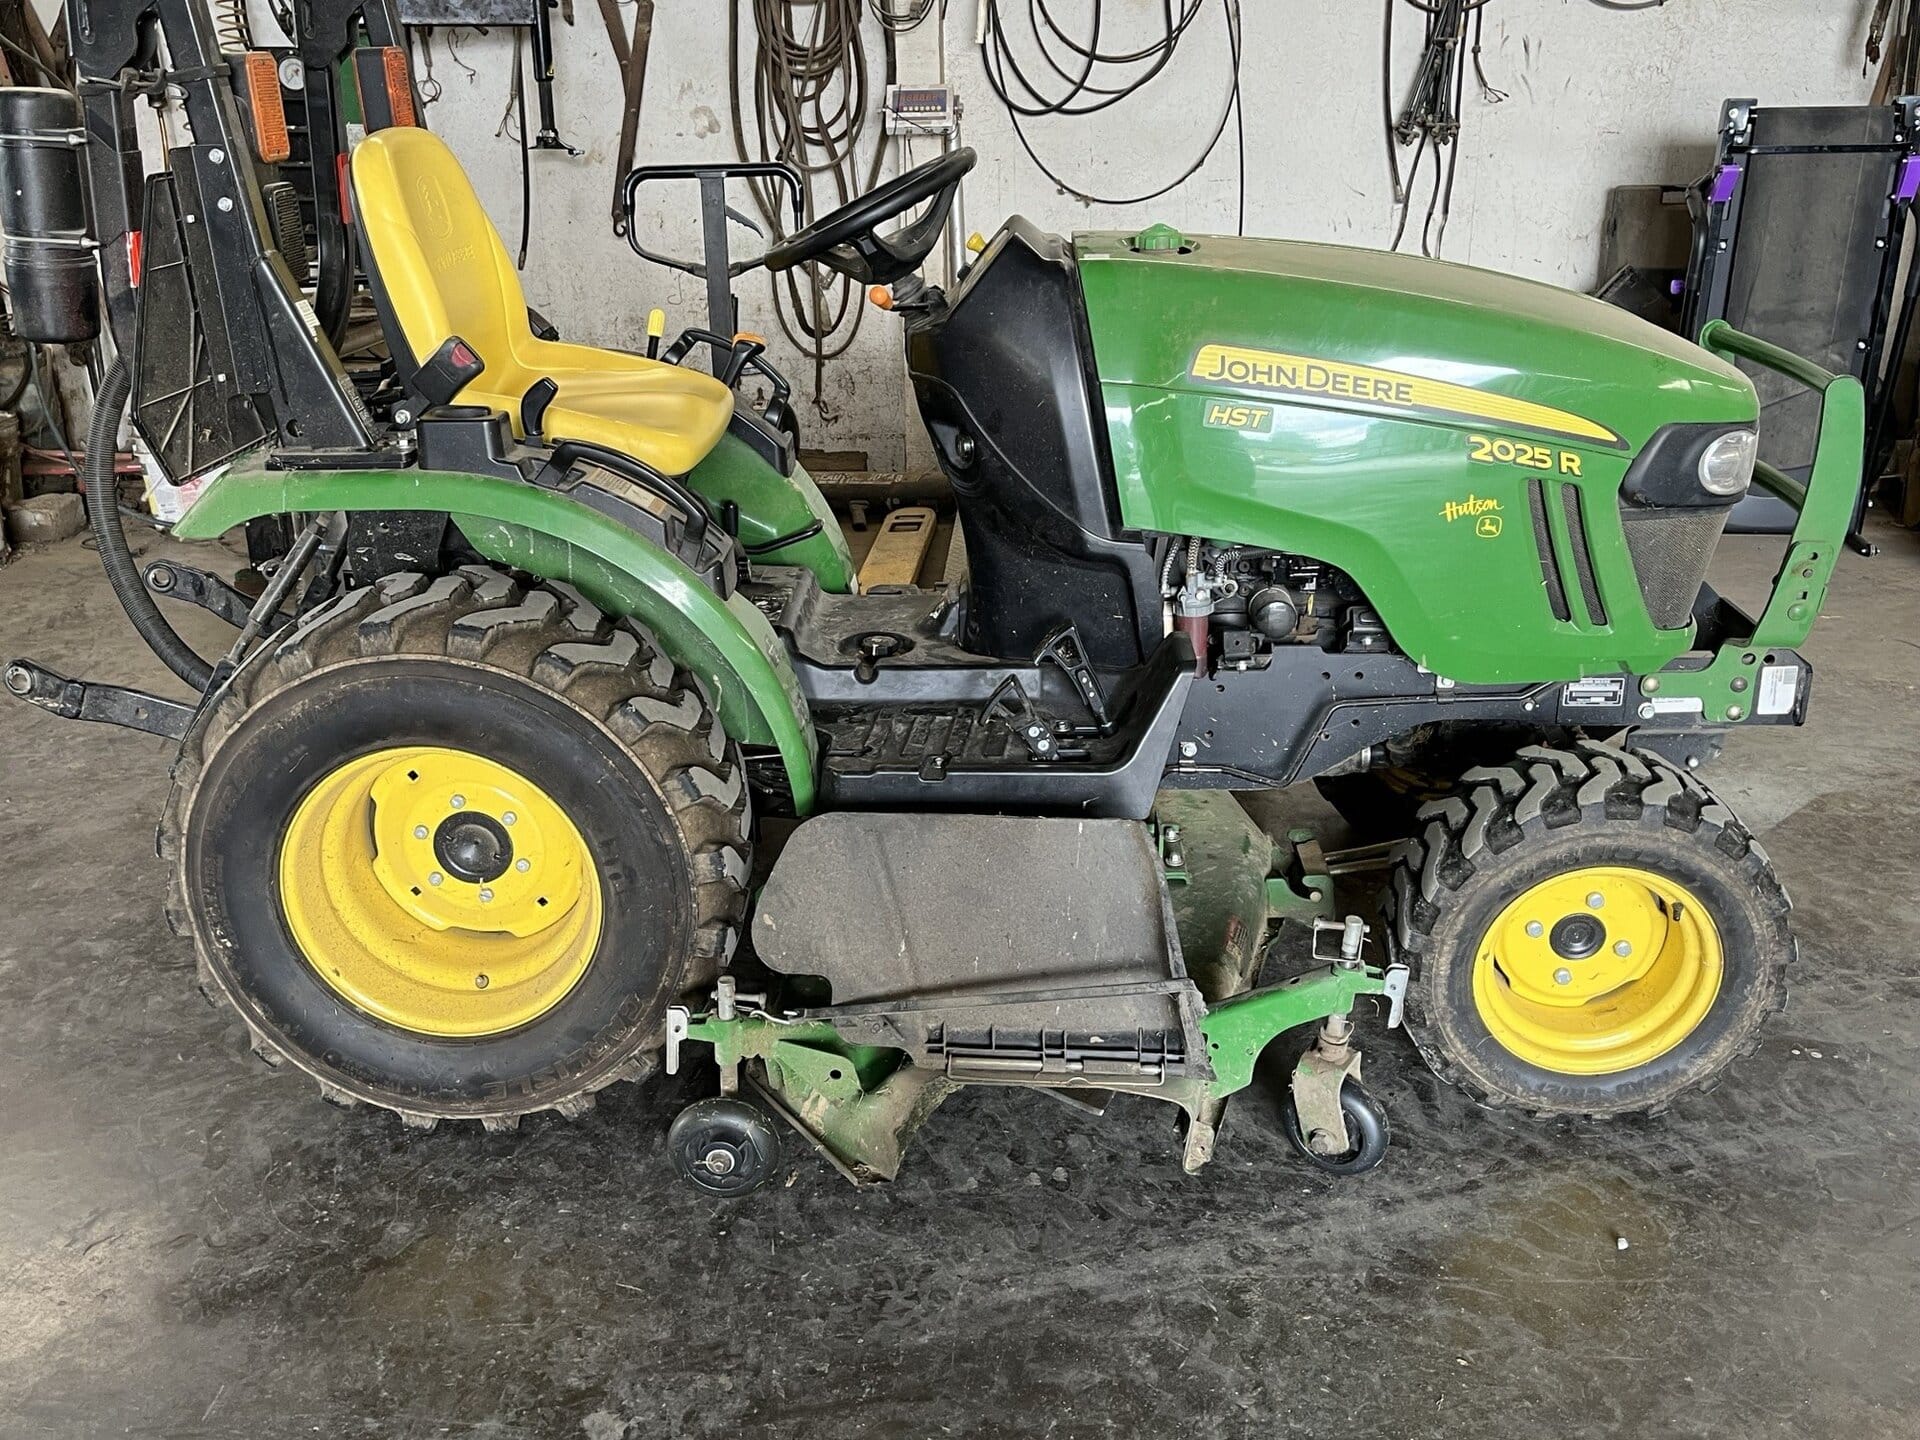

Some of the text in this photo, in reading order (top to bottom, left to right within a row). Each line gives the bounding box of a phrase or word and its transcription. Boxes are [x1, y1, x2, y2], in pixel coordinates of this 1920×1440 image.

[1208, 355, 1413, 402] JOHN DEERE
[1209, 405, 1269, 428] HST
[1467, 434, 1583, 477] 2025 R
[1438, 493, 1505, 523] Hutson
